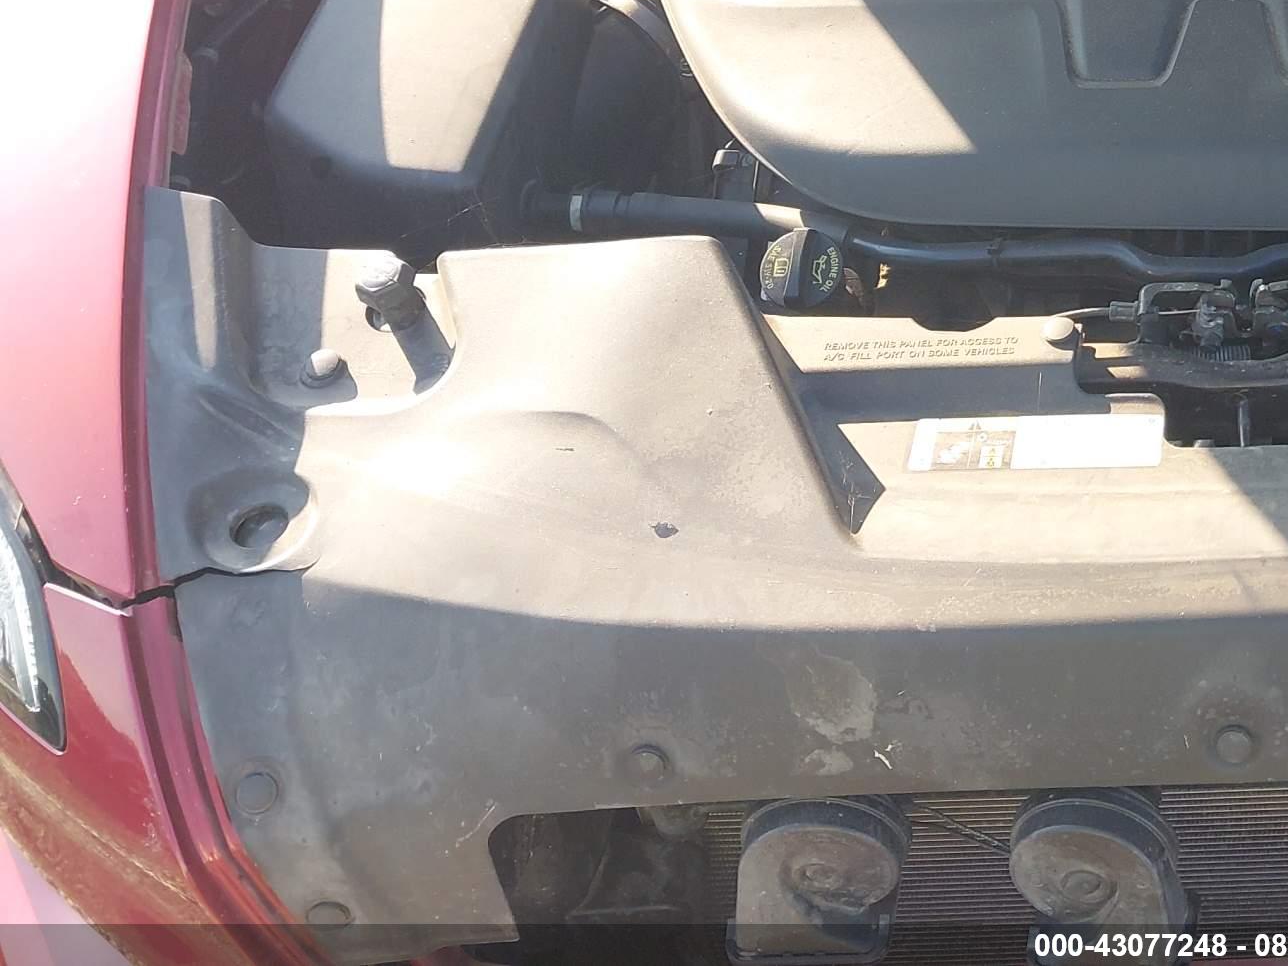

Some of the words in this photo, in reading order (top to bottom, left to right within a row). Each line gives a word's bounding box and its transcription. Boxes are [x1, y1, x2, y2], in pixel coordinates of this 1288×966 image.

[827, 246, 839, 278] ENGINE
[819, 280, 833, 292] OIL
[824, 341, 870, 351] REMOVE
[873, 340, 897, 349] THIS
[899, 339, 933, 349] PANEL
[936, 339, 958, 347] FOR
[960, 337, 1002, 346] ACCESS
[1004, 336, 1019, 345] TO
[824, 351, 846, 362] A/C
[849, 351, 873, 361] FILL
[876, 350, 906, 360] PORT
[908, 350, 925, 359] ON
[928, 348, 960, 358] SOME
[964, 346, 1016, 357] VEHICLES
